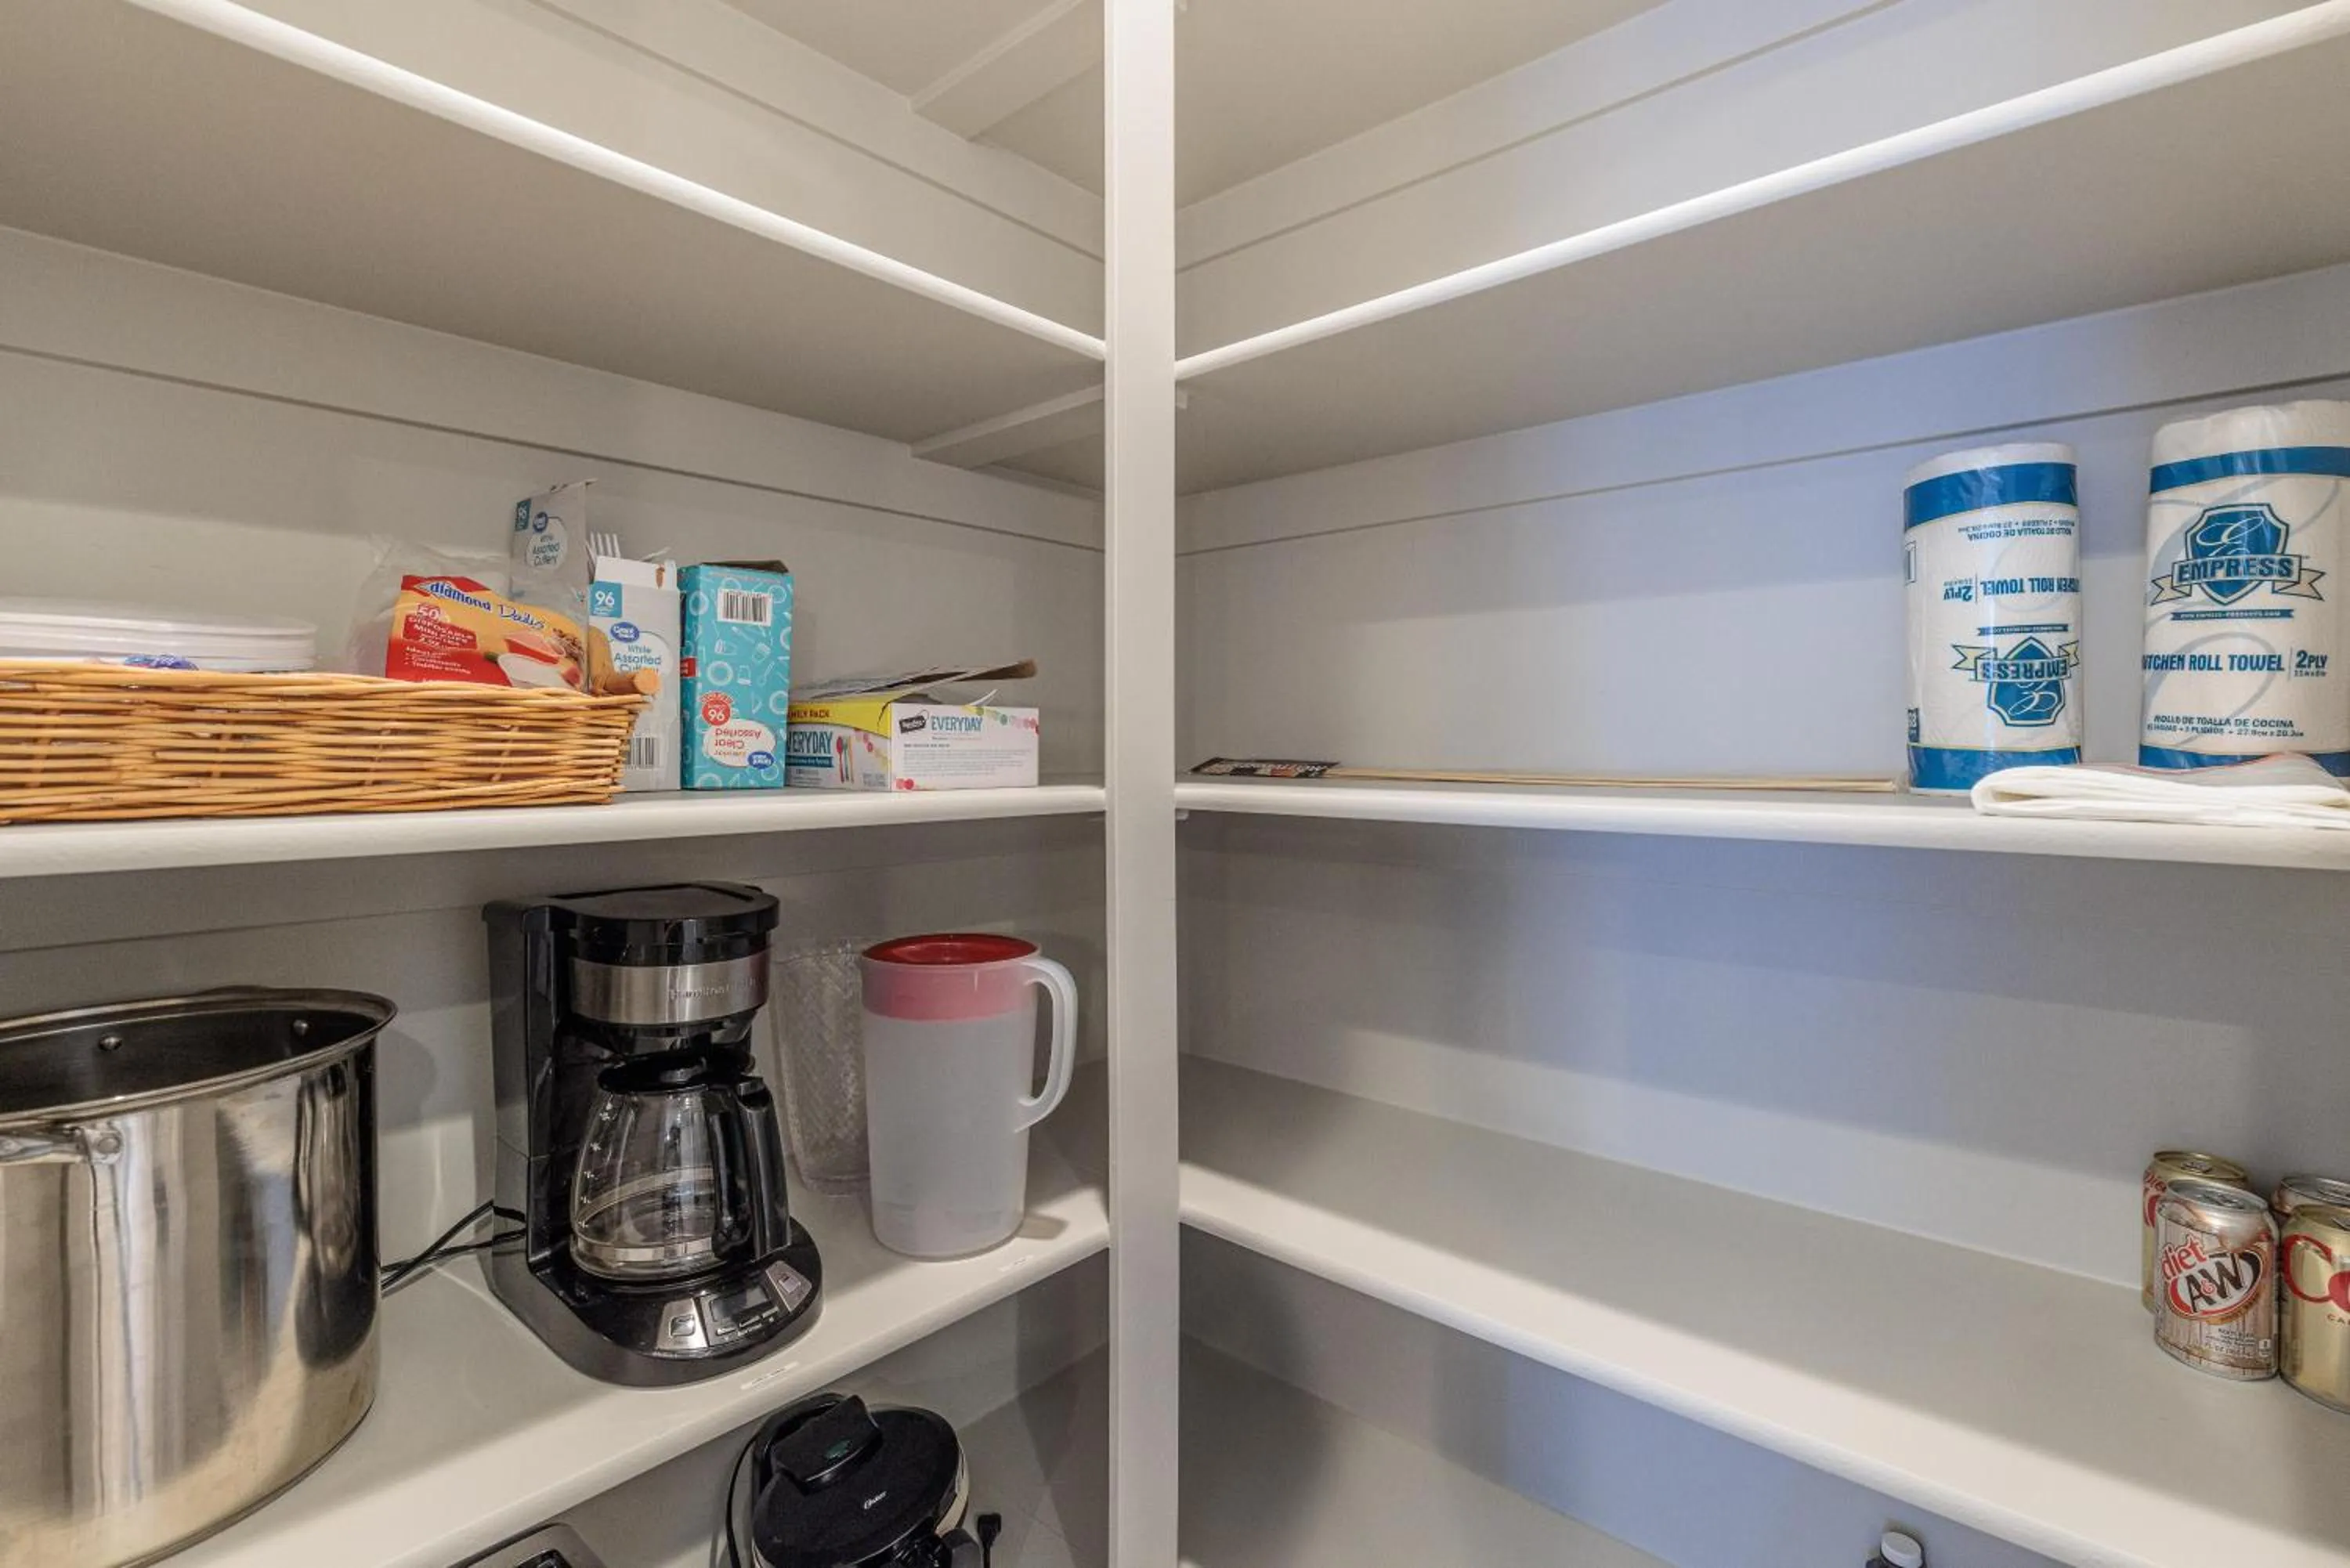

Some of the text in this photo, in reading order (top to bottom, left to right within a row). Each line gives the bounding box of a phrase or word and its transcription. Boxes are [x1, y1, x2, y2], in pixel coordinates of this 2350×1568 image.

[2178, 557, 2294, 582] EMPRESS
[1979, 579, 2025, 596] TOWEL
[2028, 577, 2055, 593] ROLL
[430, 581, 492, 612] diamond
[595, 591, 615, 605] 96
[614, 652, 663, 665] Assorted
[2189, 655, 2223, 671] ROLL
[2228, 654, 2285, 672] TOWEL
[1982, 659, 2068, 679] EMPRESS
[708, 709, 725, 721] 96
[2235, 718, 2251, 728] DE
[2252, 719, 2294, 728] COCINA
[931, 716, 983, 732] EVERYDAY
[714, 728, 762, 739] Assorted
[714, 739, 744, 750] Clear
[2162, 1234, 2207, 1280] diet
[2186, 1252, 2245, 1313] A&W
